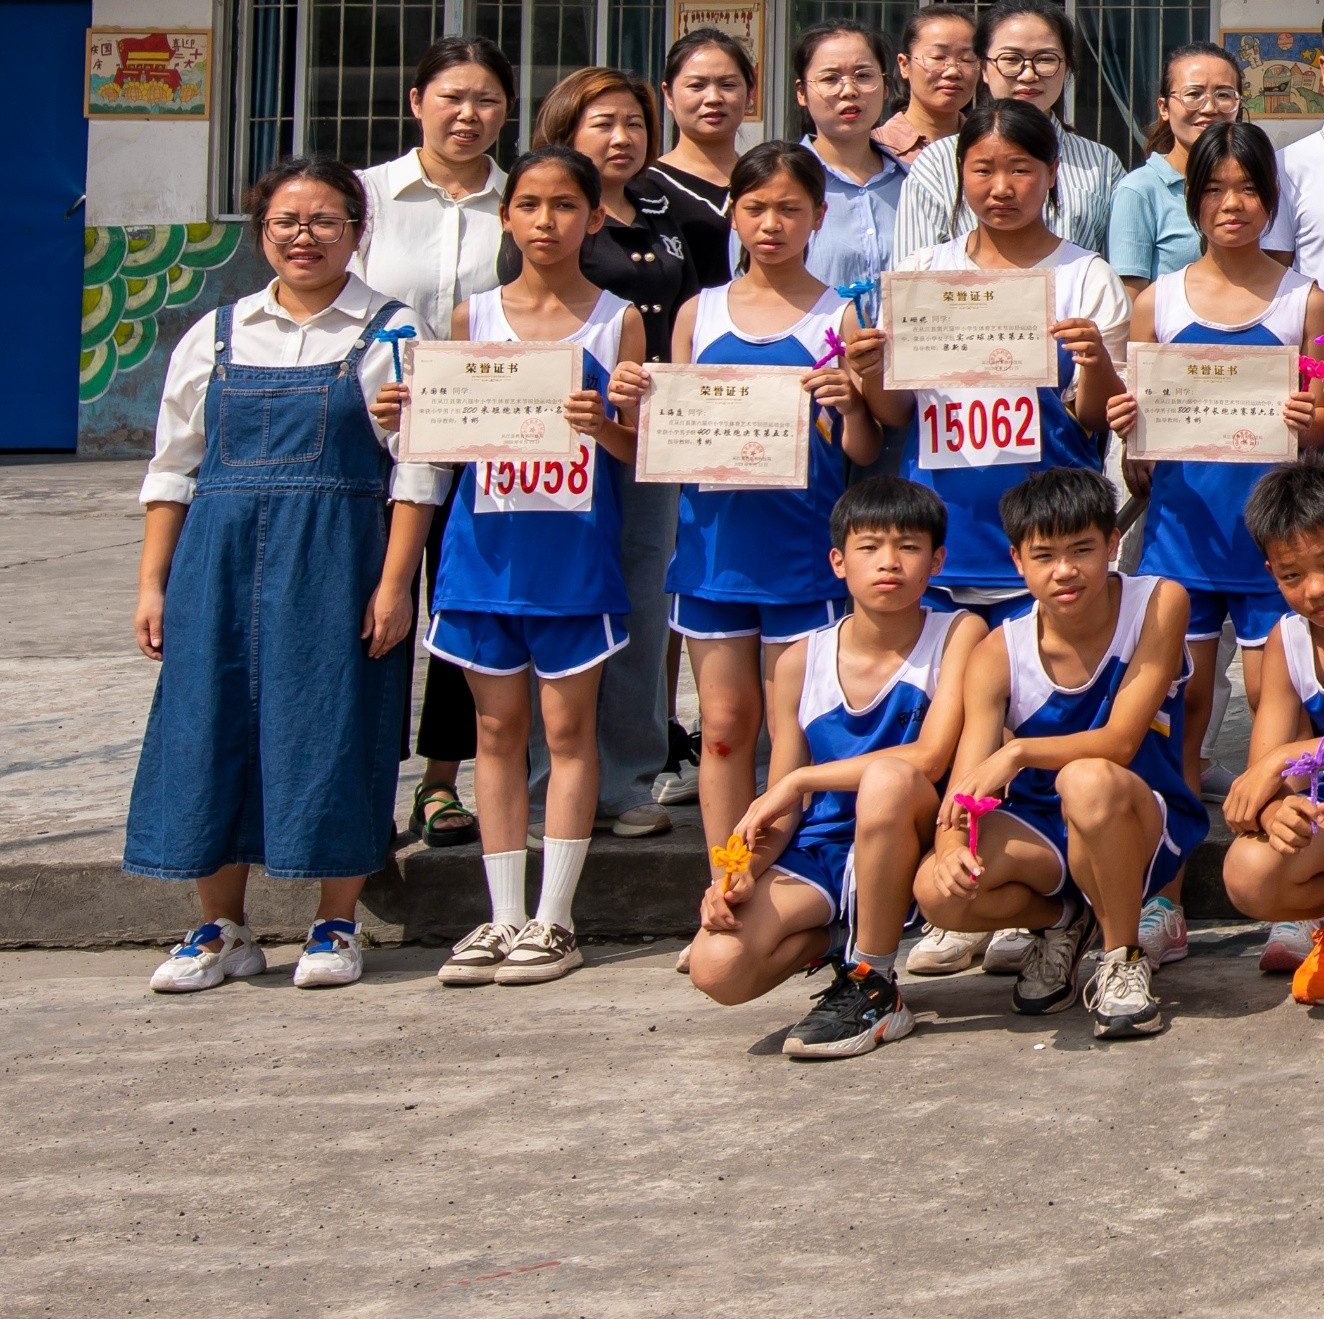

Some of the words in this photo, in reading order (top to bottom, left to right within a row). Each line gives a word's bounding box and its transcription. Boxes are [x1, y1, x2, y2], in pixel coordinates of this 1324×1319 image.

[943, 291, 994, 302] 荣誉证书
[466, 363, 518, 373] 荣誉证书
[1188, 365, 1238, 375] 荣誉证书
[700, 386, 749, 396] 荣誉证书
[923, 395, 1036, 454] 15062
